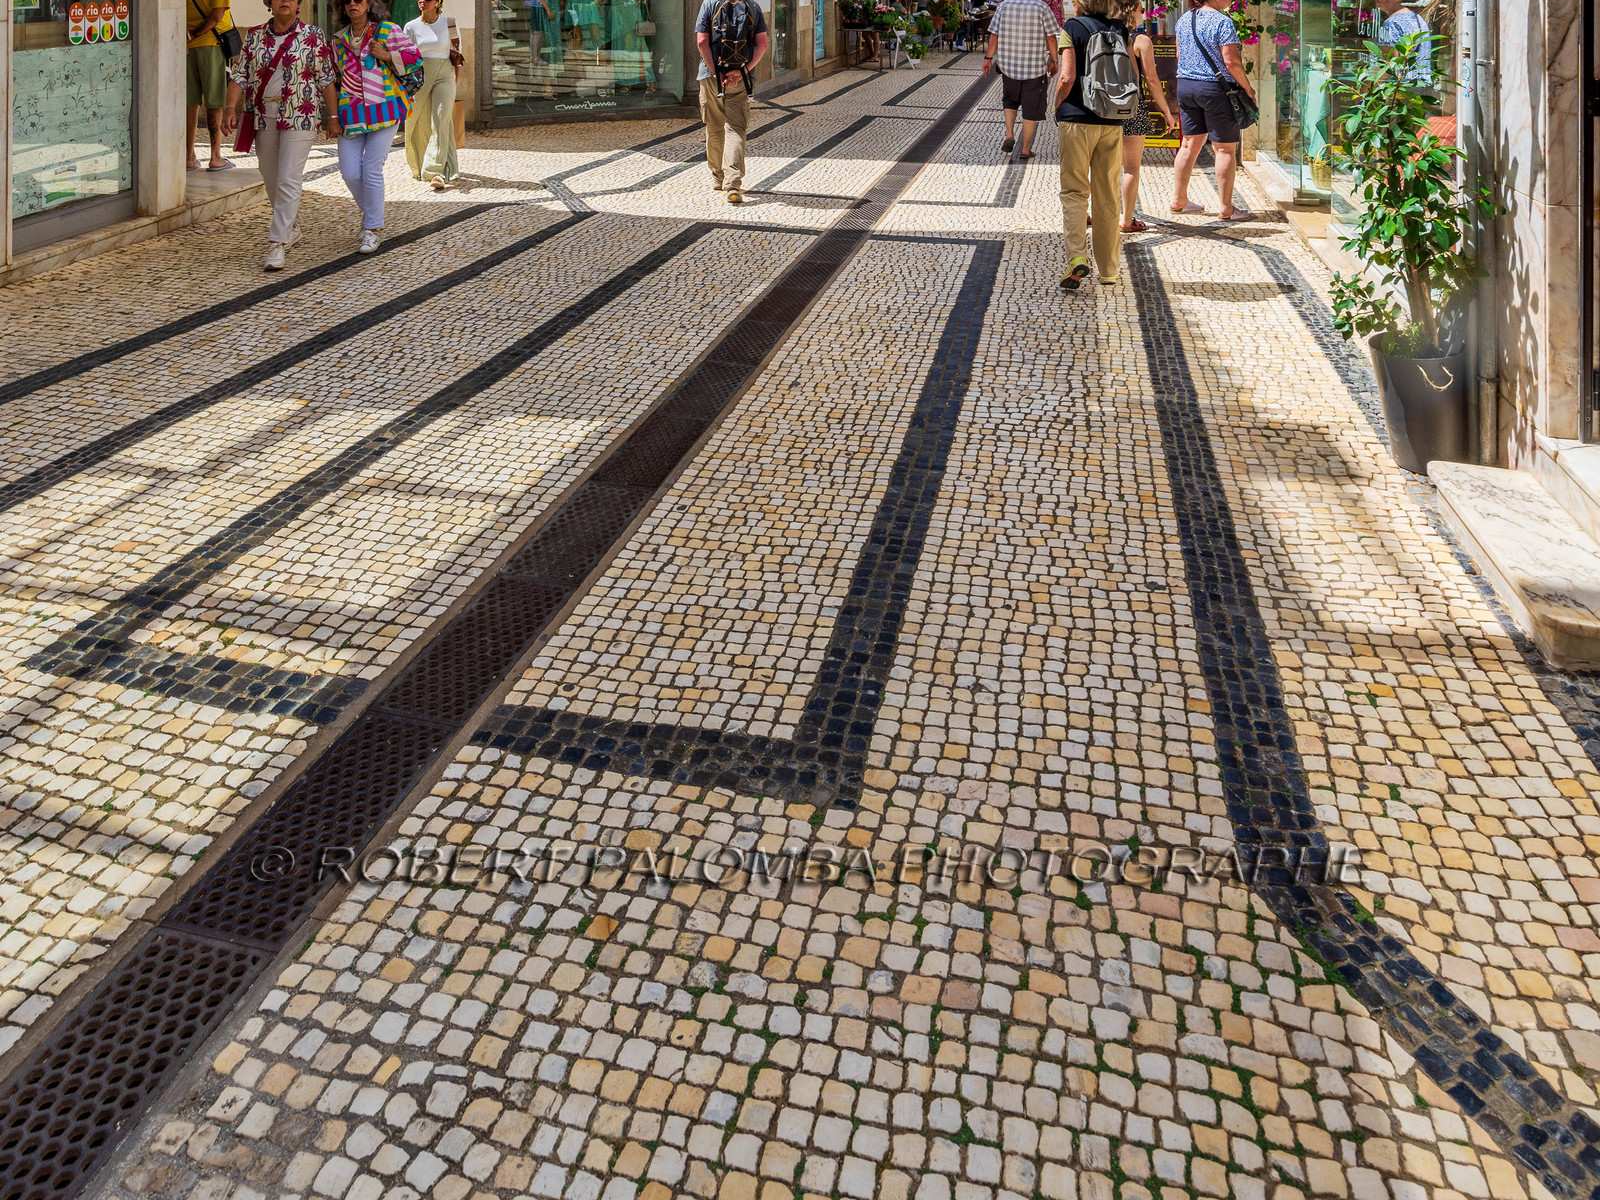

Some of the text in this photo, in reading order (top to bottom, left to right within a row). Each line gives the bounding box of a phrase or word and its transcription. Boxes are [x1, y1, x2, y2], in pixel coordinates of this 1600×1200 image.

[71, 5, 83, 16] ria
[86, 4, 99, 16] ria
[101, 3, 113, 14] ria
[116, 2, 127, 13] ria
